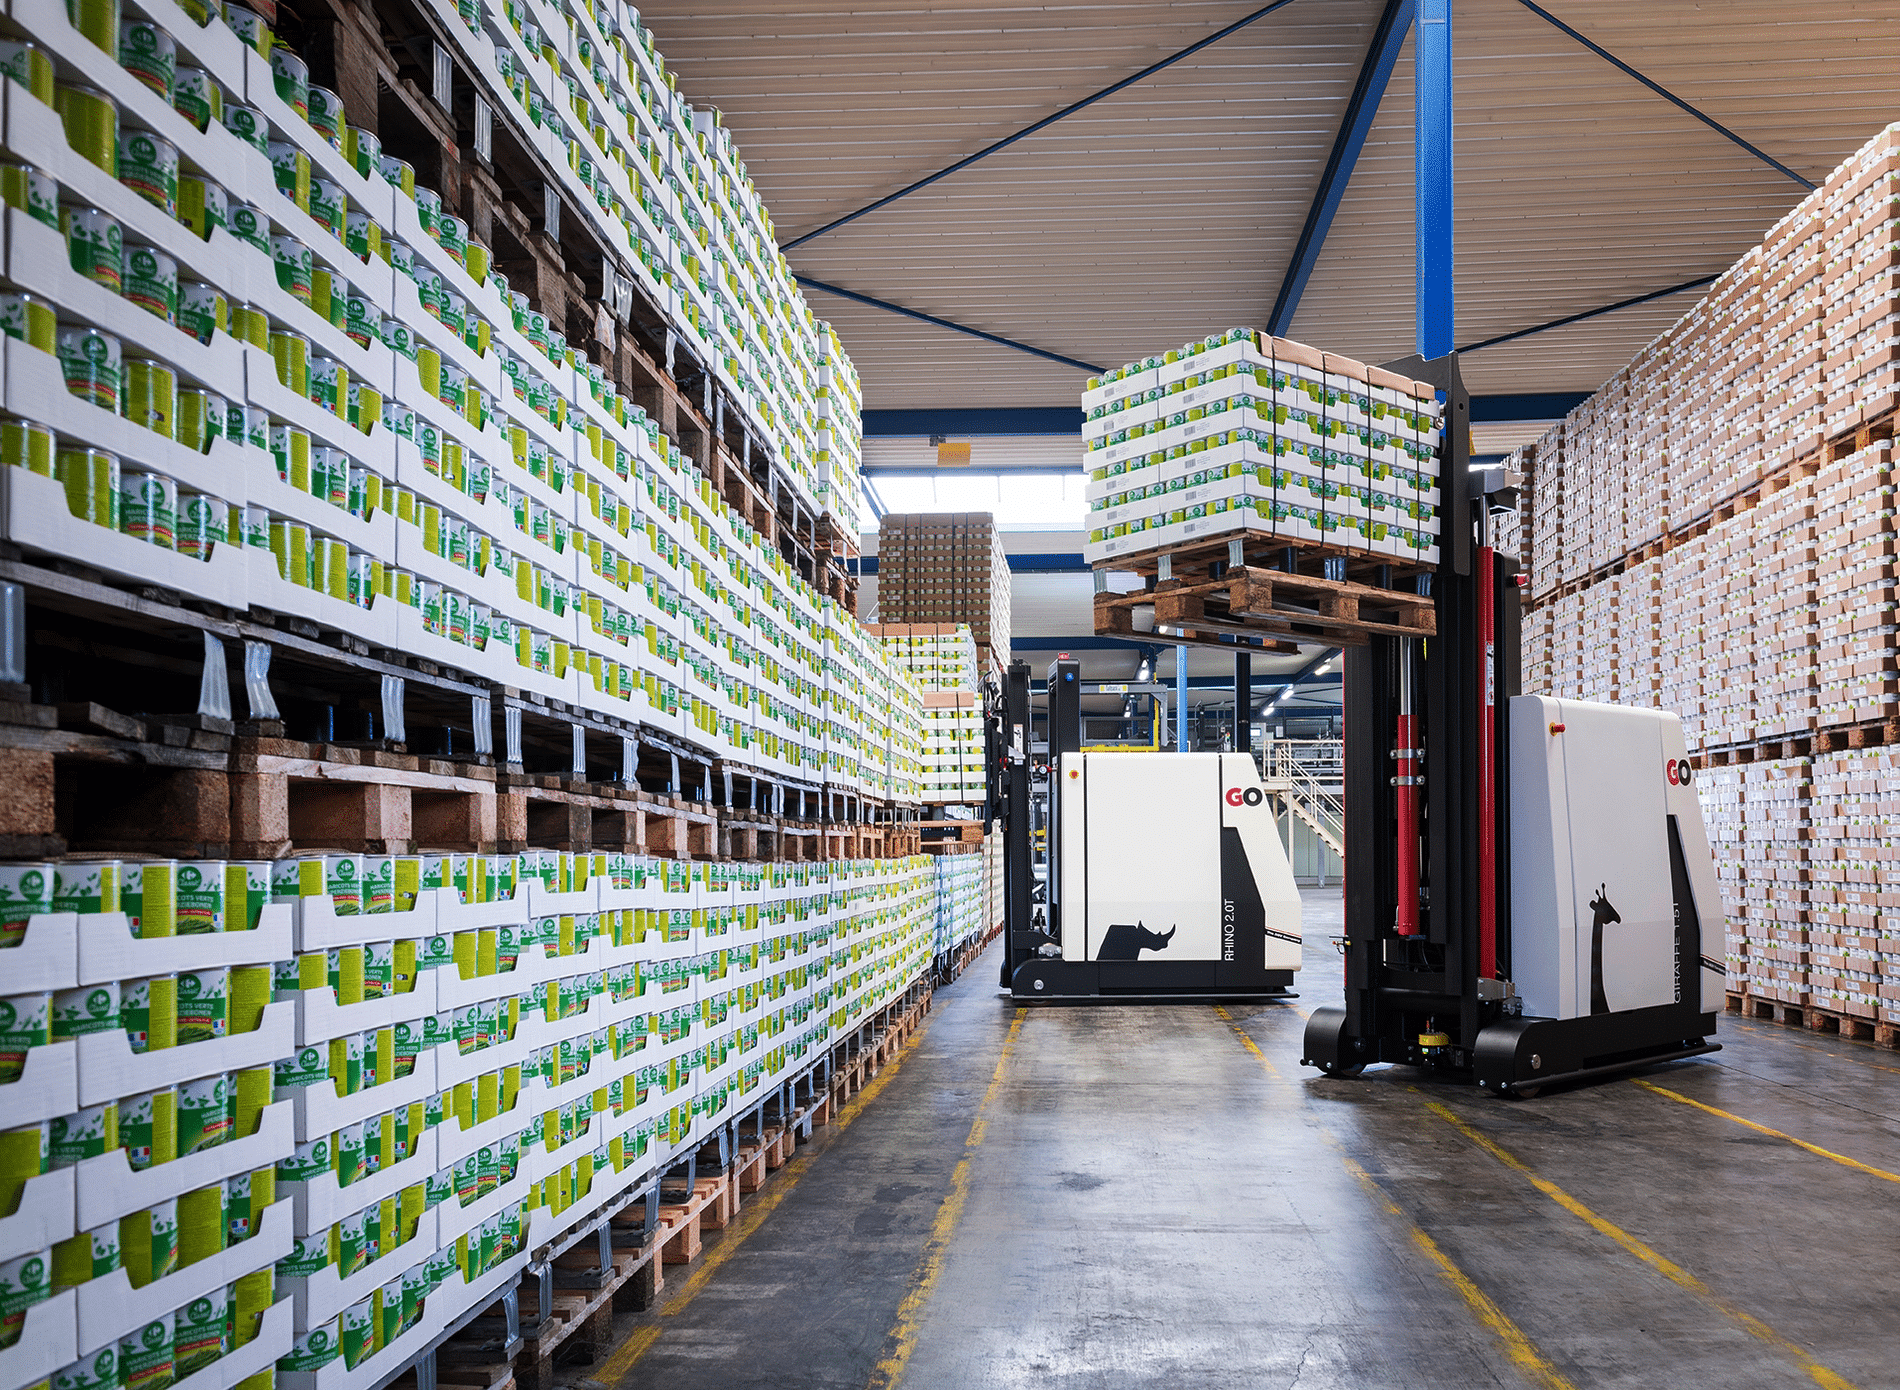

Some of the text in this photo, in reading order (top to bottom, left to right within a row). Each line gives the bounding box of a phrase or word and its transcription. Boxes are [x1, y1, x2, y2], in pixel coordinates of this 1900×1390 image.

[1667, 758, 1691, 787] GO
[1225, 787, 1263, 807] GO
[1224, 898, 1235, 961] RHINO 2.0T
